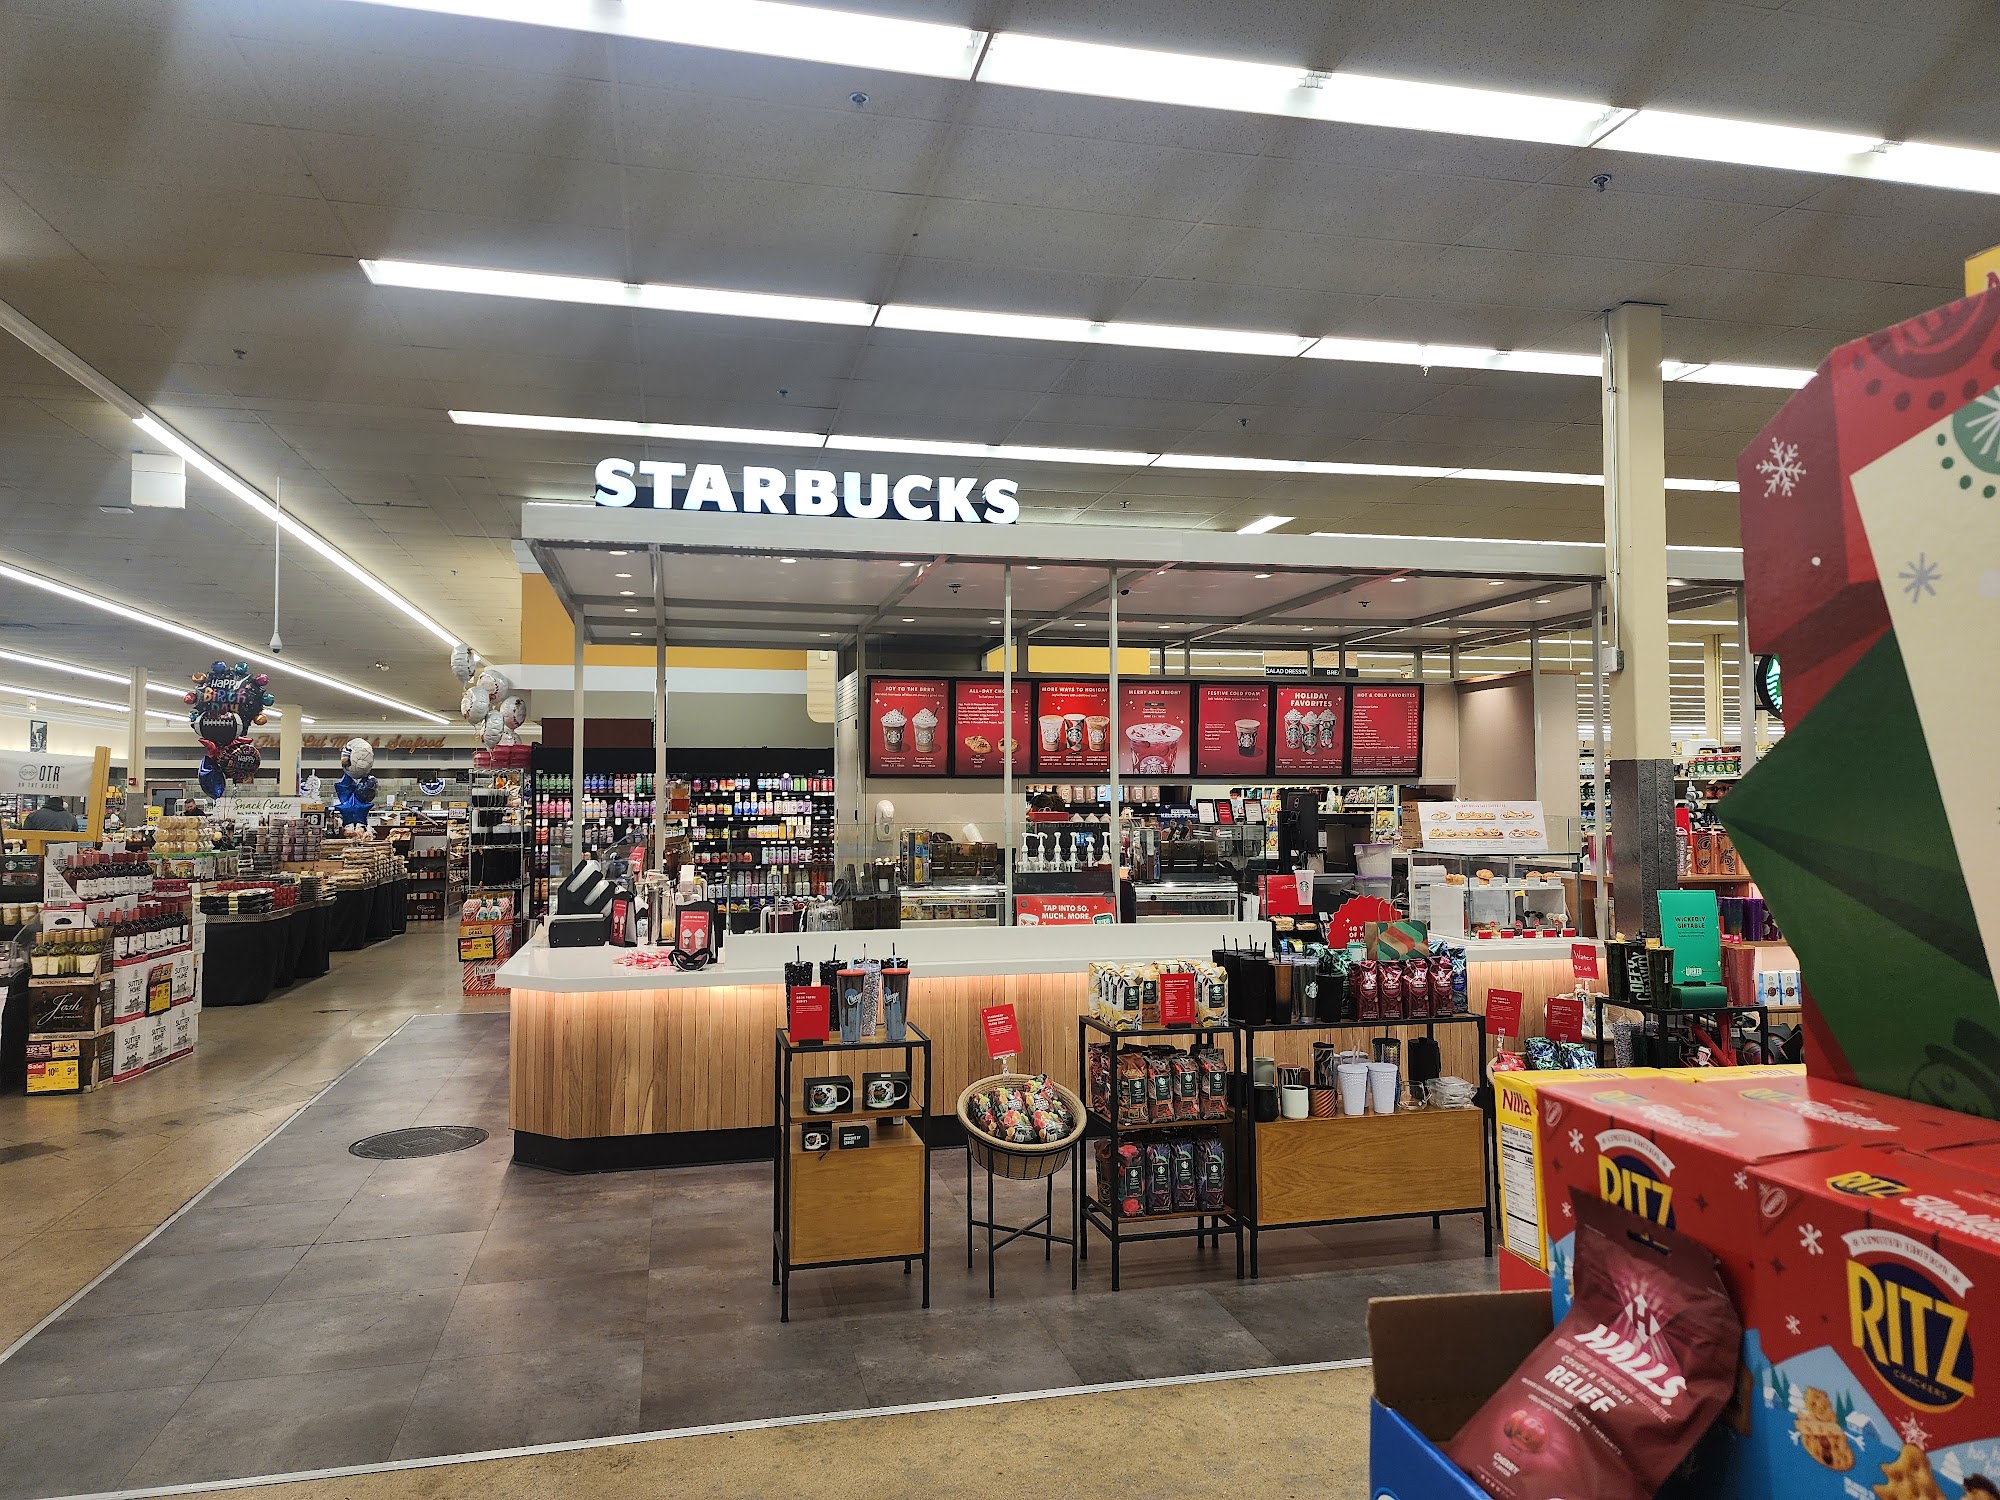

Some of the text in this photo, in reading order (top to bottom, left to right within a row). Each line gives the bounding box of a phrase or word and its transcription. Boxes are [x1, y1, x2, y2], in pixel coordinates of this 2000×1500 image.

[593, 457, 1020, 525] STARBUCKS
[384, 735, 446, 753] Seafood
[39, 766, 60, 782] OTR
[233, 798, 292, 810] Snack Center
[1573, 950, 1594, 960] Water
[175, 966, 189, 975] SUTTER
[1628, 960, 1645, 993] DEFY
[128, 979, 143, 988] SUTTER
[37, 993, 82, 1026] Josh
[175, 1017, 190, 1026] SUTTER
[177, 1024, 189, 1032] HOME
[151, 1026, 166, 1036] SUTTER
[153, 1033, 164, 1042] HOME
[124, 1035, 141, 1045] SUTTER
[126, 1041, 139, 1050] HOME
[1503, 1088, 1532, 1116] Nilla
[1520, 1129, 1532, 1140] Facts
[1608, 1135, 1661, 1160] LIMITED EDITION
[1862, 1235, 1948, 1275] LIMITED EDITION
[1846, 1259, 1975, 1398] RITZ
[1544, 1364, 1617, 1413] RELIEF
[1597, 1376, 1633, 1406] THROAT
[1892, 1368, 1948, 1400] CRACKERS
